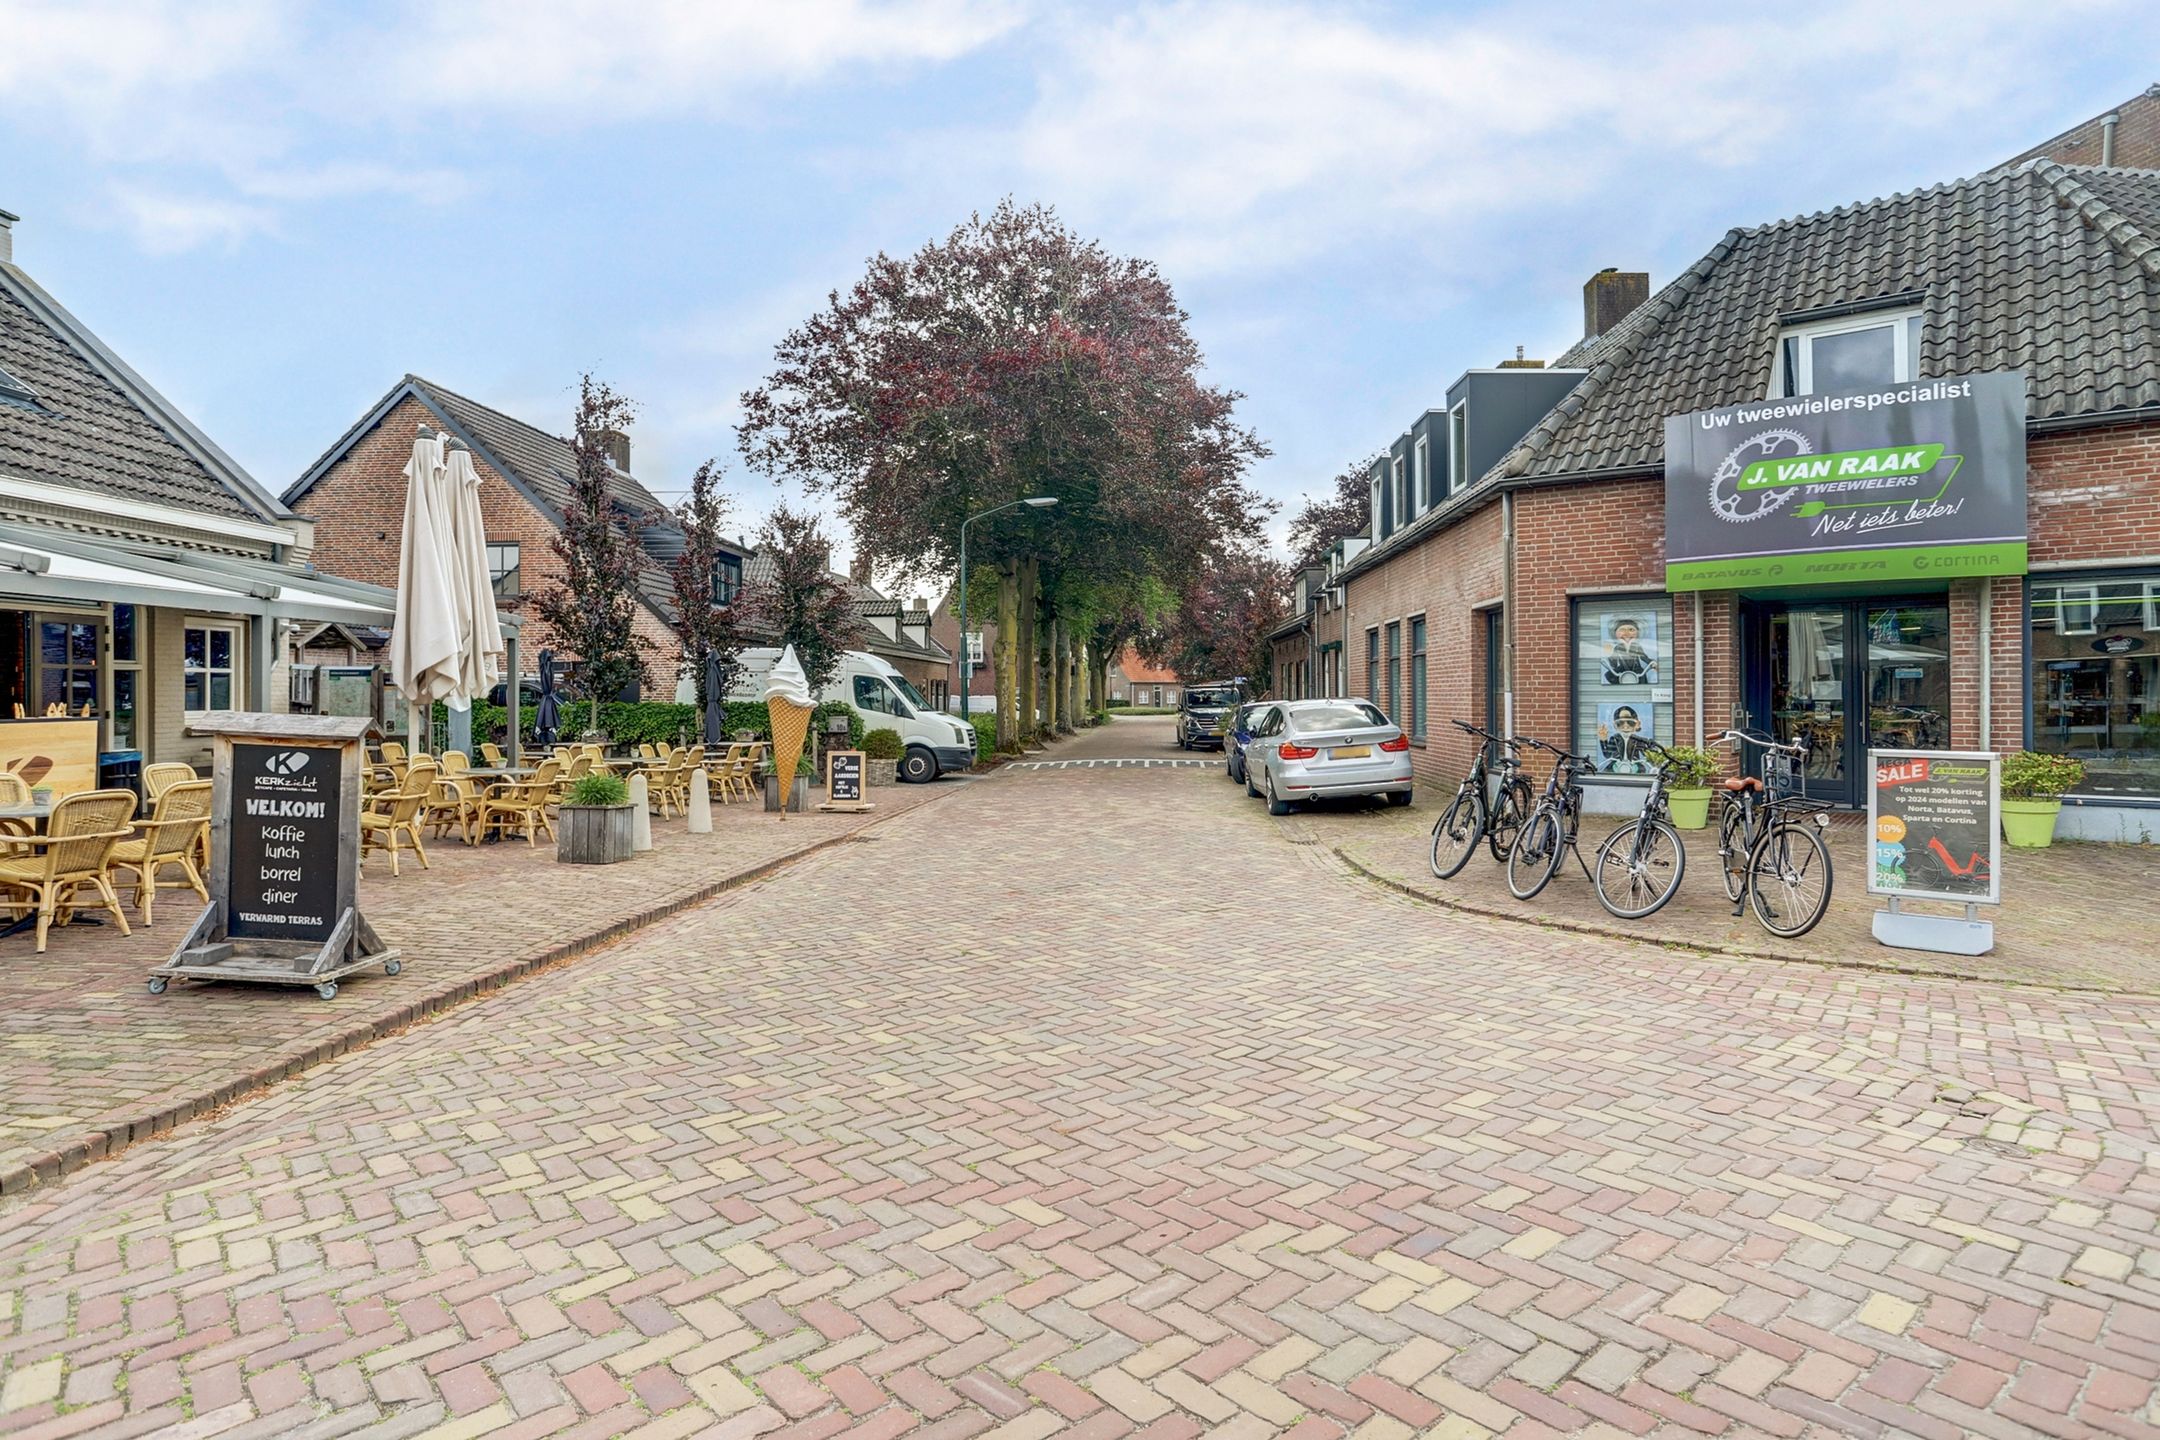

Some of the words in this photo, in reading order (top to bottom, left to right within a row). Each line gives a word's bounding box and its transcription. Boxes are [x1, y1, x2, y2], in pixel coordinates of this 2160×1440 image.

[1701, 413, 1731, 430] Uw
[1736, 380, 1971, 424] tweewielerspecialist
[1746, 467, 1768, 485] J.
[1776, 460, 1832, 482] VAN
[1838, 450, 1926, 475] RAAK
[1805, 475, 1919, 495] TWEEWIELERS
[1811, 511, 1856, 537] Net
[1859, 506, 1899, 529] iets
[1904, 498, 1965, 522] beter!
[1681, 567, 1763, 581] BATAVUS
[1805, 560, 1888, 574] NORTA
[1876, 763, 1924, 783] SALE
[1914, 786, 1930, 794] wel
[1950, 788, 1983, 797] korting
[246, 798, 326, 819] WELKOM!
[1928, 797, 1969, 805] modellen
[1908, 805, 1935, 814] Norta,
[1936, 806, 1974, 816] Batavus,
[1902, 814, 1931, 823] Sparta
[1944, 816, 1977, 825] Cortina
[1878, 823, 1902, 834] 10%
[265, 843, 300, 860] lunch
[1877, 847, 1903, 859] 15%
[260, 865, 302, 882] borrel
[1877, 872, 1904, 884] 20%
[261, 888, 298, 905] diner
[239, 911, 287, 925] VERWARMD
[288, 914, 323, 926] TERRAS
